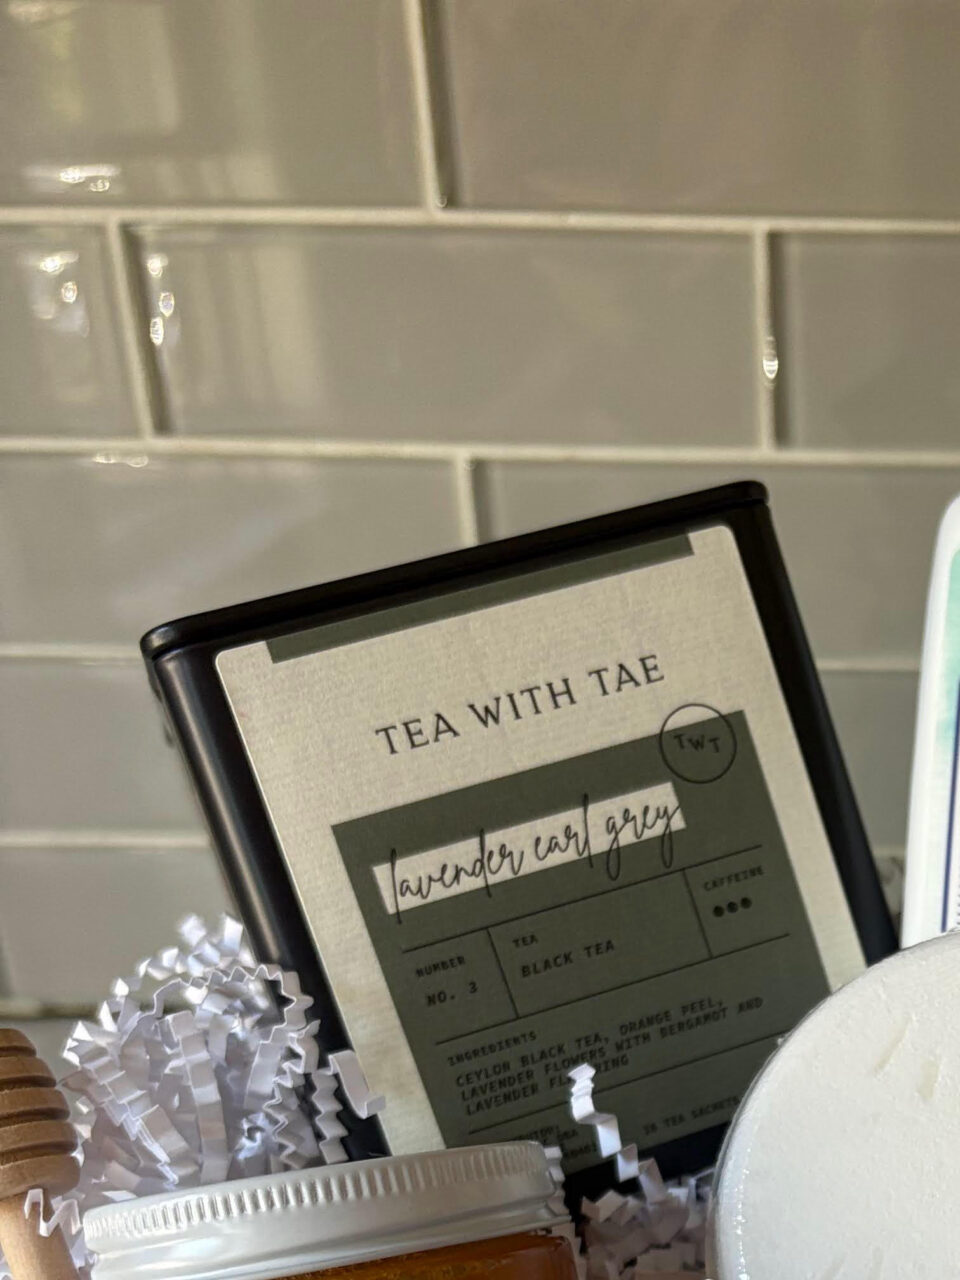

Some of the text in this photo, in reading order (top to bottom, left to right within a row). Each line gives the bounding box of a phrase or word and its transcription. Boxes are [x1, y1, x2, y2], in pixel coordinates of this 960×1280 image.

[375, 655, 665, 754] TEA WITH TAE
[673, 734, 721, 753] TWT
[391, 793, 680, 924] lavender earl grey
[703, 865, 764, 892] CAFFEINE
[512, 934, 538, 948] TEA
[416, 956, 466, 978] NUMBER
[521, 940, 615, 978] BLACK TEA
[426, 981, 478, 1006] NO. 3
[447, 1031, 537, 1066] INGREDIENTS
[456, 997, 723, 1087] CEYLON BLACK TEA, ORANGE PEEL,
[461, 997, 764, 1101] LAVENDER FLOWERS WITH BERGAMOT AND
[466, 1083, 539, 1116] LAVENDER
